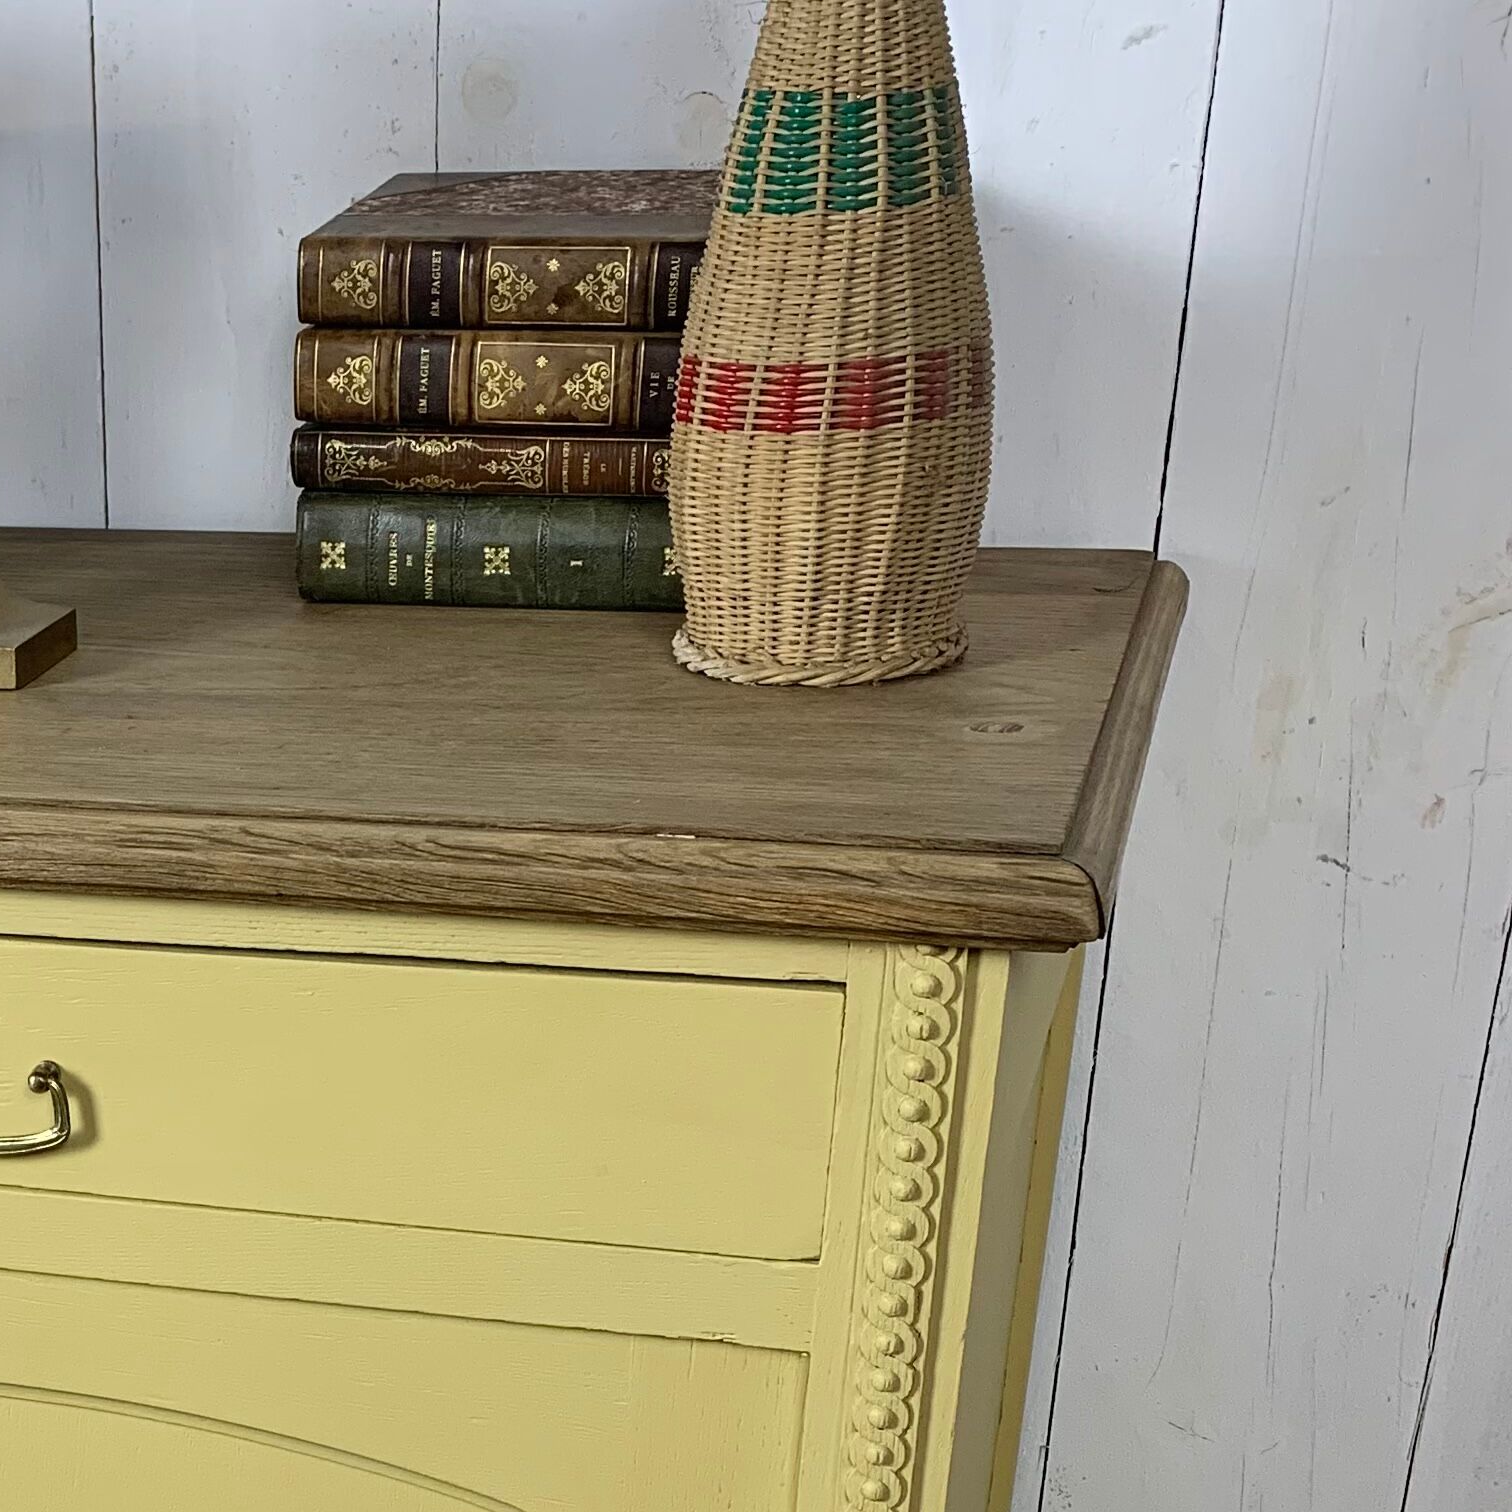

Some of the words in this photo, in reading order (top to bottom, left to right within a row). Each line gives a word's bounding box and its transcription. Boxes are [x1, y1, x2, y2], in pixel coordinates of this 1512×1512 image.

[431, 249, 442, 295] FAGUET
[667, 255, 681, 317] ROUSSEAU
[419, 347, 431, 392] FAGUET
[649, 371, 660, 398] VIE
[666, 375, 675, 390] DE
